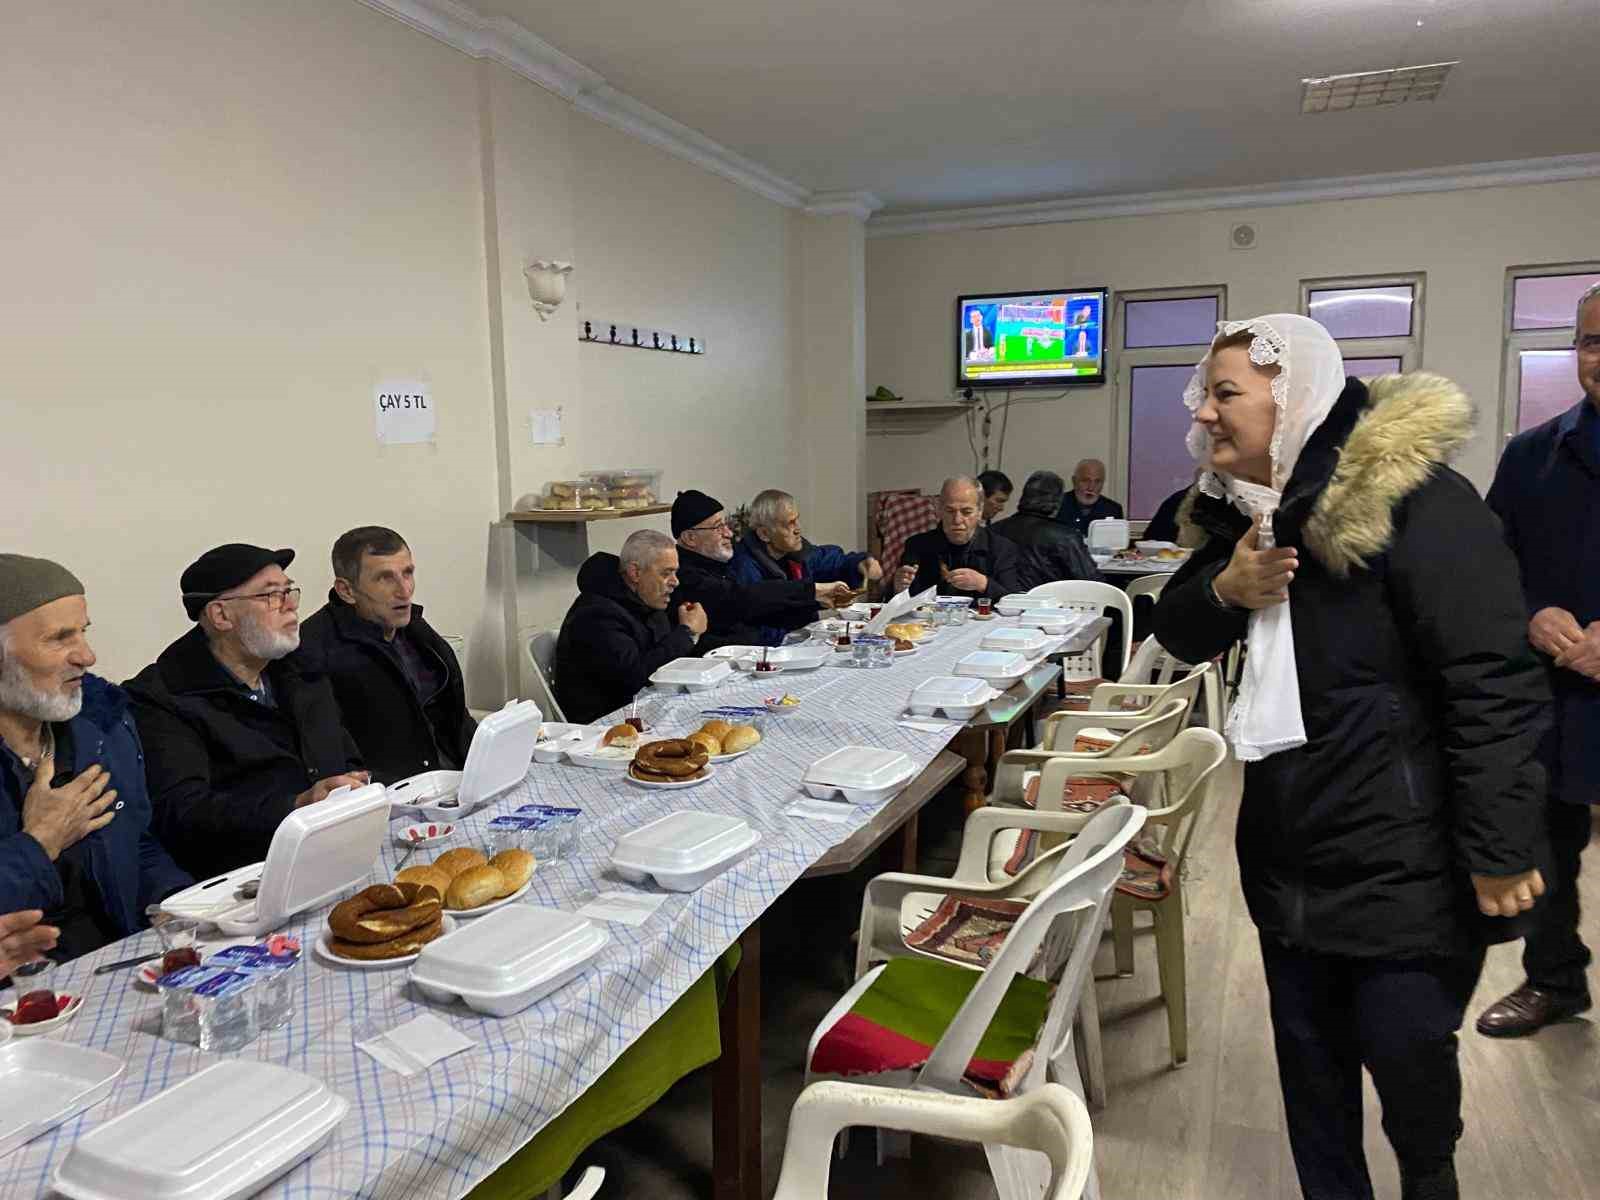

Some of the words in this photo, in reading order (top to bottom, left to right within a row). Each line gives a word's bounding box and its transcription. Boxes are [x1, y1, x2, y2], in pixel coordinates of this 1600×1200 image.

[379, 394, 401, 412] ÇAY
[404, 395, 411, 409] 5
[413, 395, 427, 409] TL
